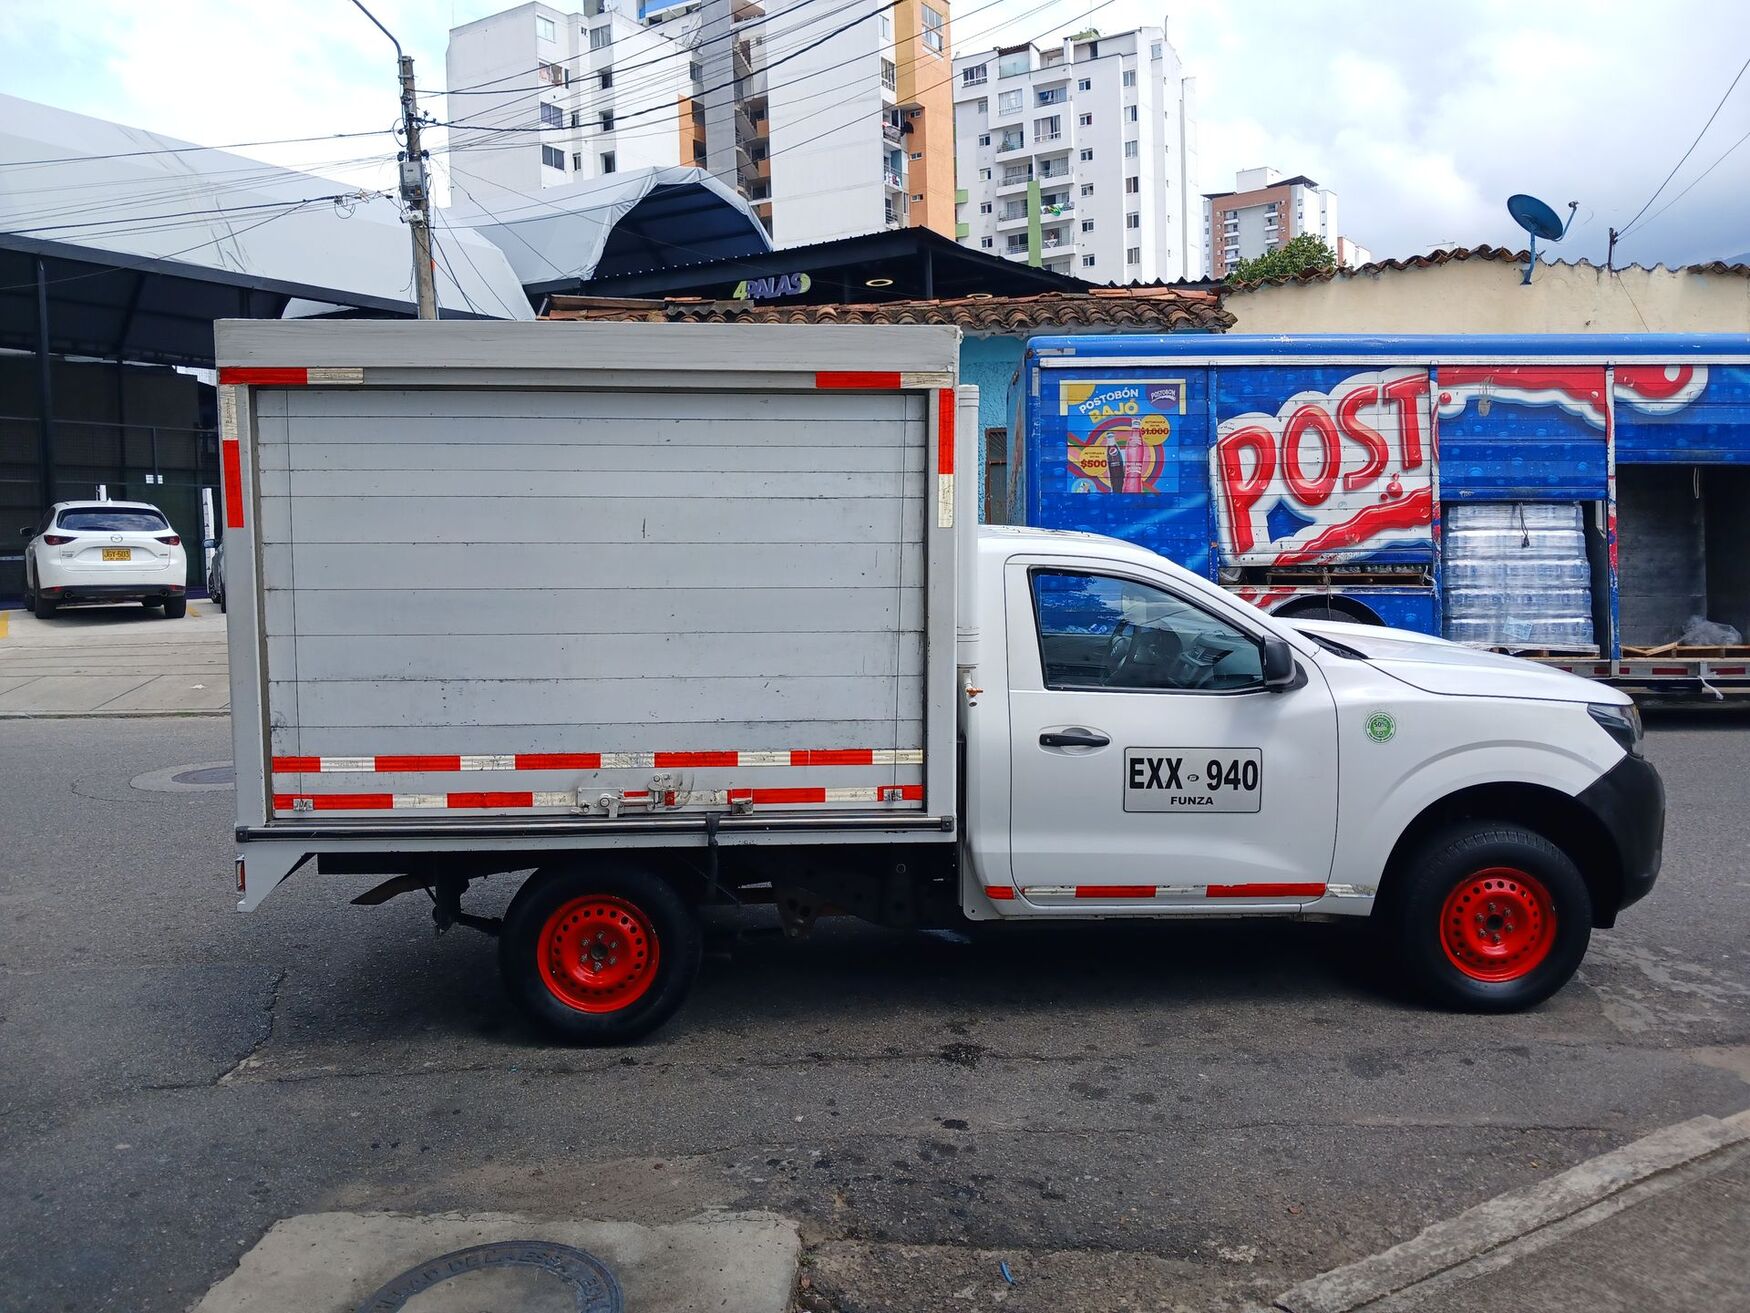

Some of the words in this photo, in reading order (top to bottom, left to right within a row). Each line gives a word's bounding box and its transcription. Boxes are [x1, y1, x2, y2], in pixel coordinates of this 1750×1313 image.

[1079, 387, 1139, 413] POSTOBÓN
[1088, 399, 1139, 423] BAJÓ
[1140, 427, 1169, 436] $1.000
[1081, 459, 1107, 468] $500
[1129, 758, 1183, 789] EXX
[1206, 759, 1258, 791] 940
[1170, 796, 1214, 805] FUNZA
